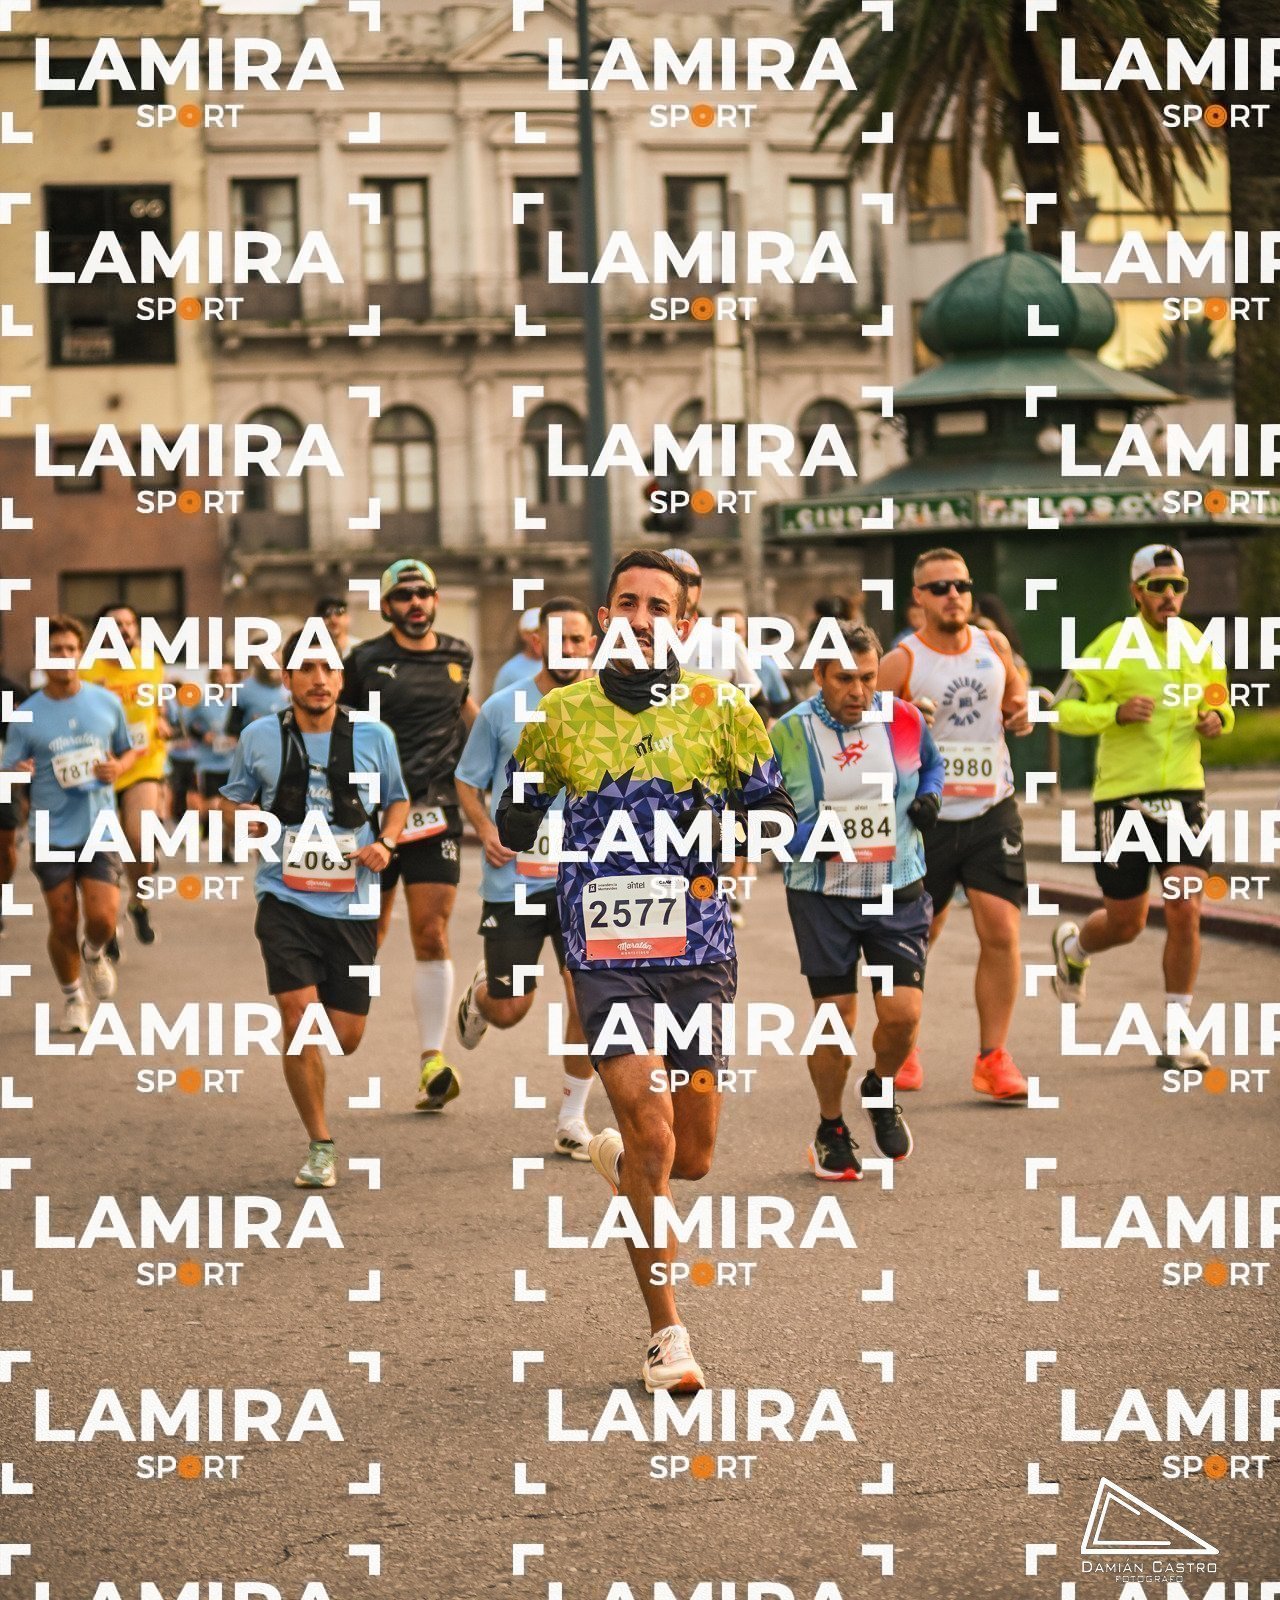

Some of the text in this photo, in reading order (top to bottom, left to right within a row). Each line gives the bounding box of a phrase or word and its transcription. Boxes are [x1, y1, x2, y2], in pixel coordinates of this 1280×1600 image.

[797, 501, 957, 528] CIUDAELA
[405, 812, 439, 829] 83
[843, 816, 892, 840] 884
[588, 897, 677, 929] 2577
